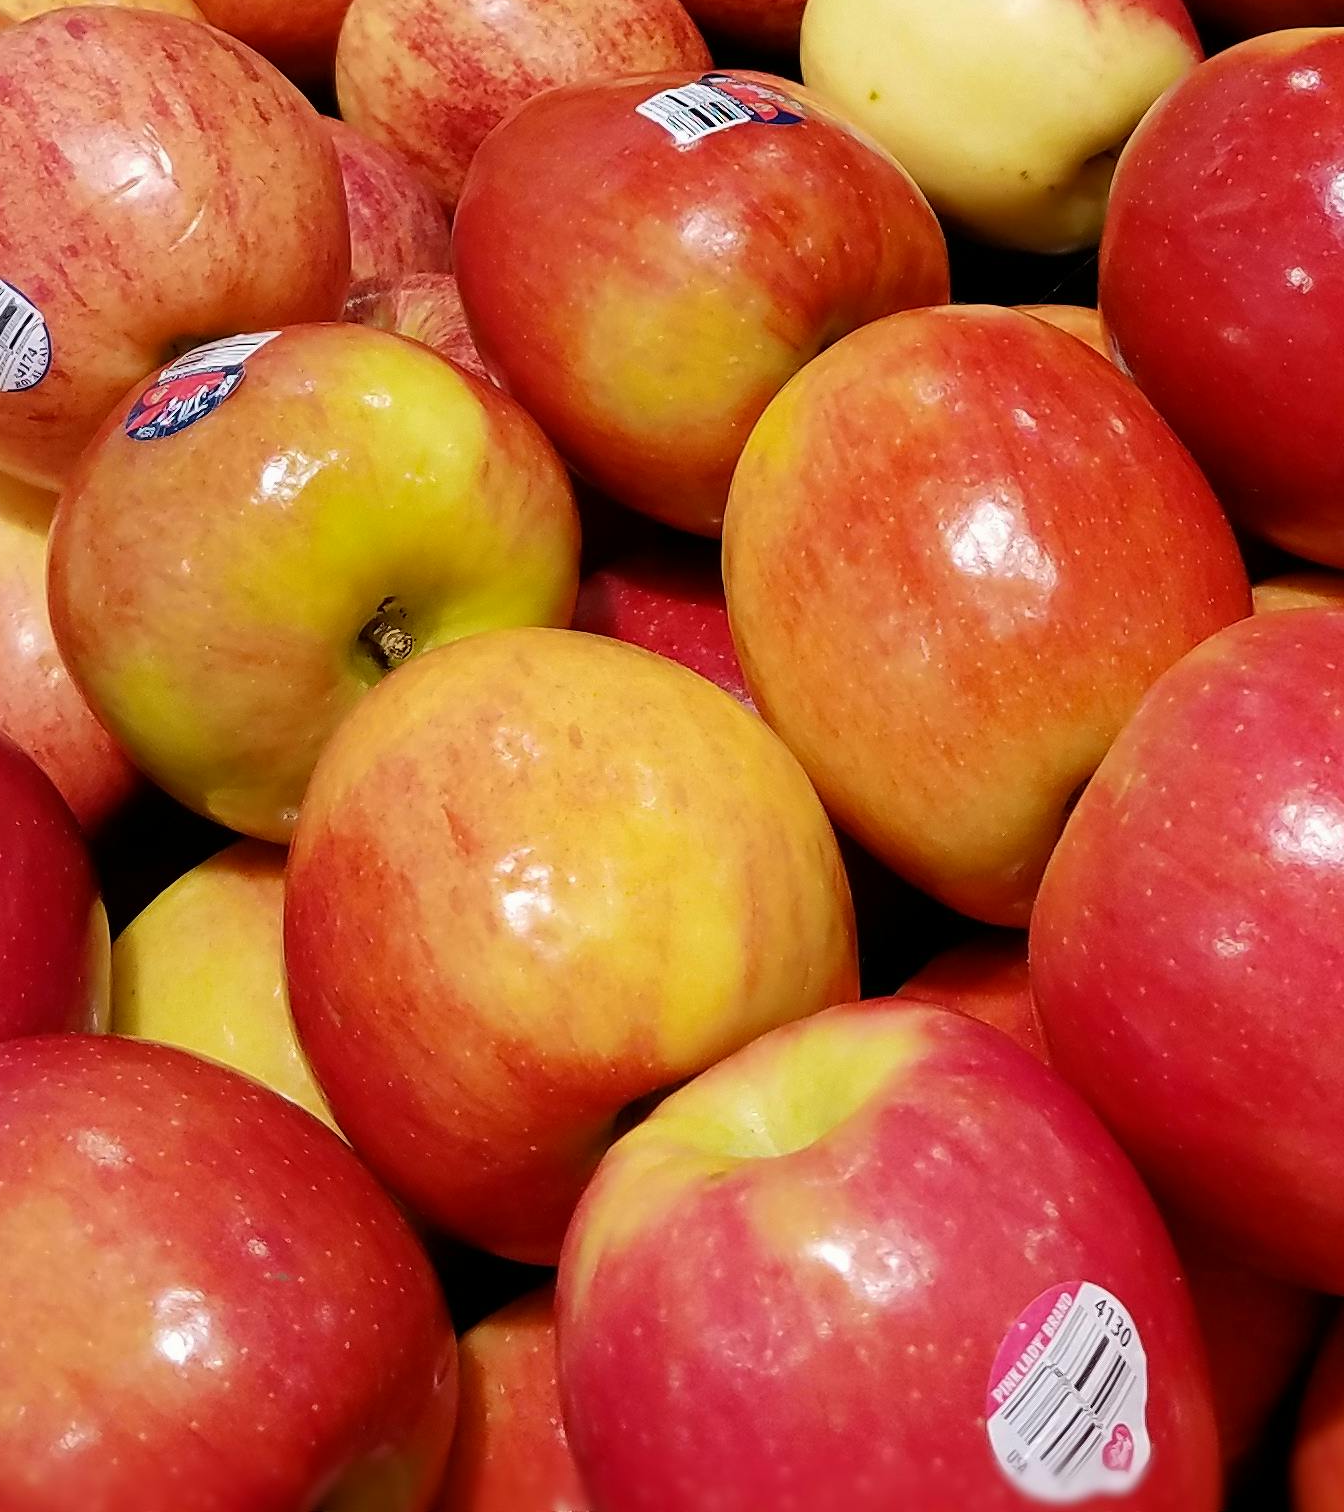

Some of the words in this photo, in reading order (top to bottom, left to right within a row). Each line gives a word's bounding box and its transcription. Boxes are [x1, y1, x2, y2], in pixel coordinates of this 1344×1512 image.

[15, 348, 37, 378] 4174
[990, 1370, 1023, 1404] PINK
[1015, 1332, 1046, 1377] LADY
[1040, 1291, 1073, 1337] BRAND
[1094, 1299, 1132, 1348] 4130
